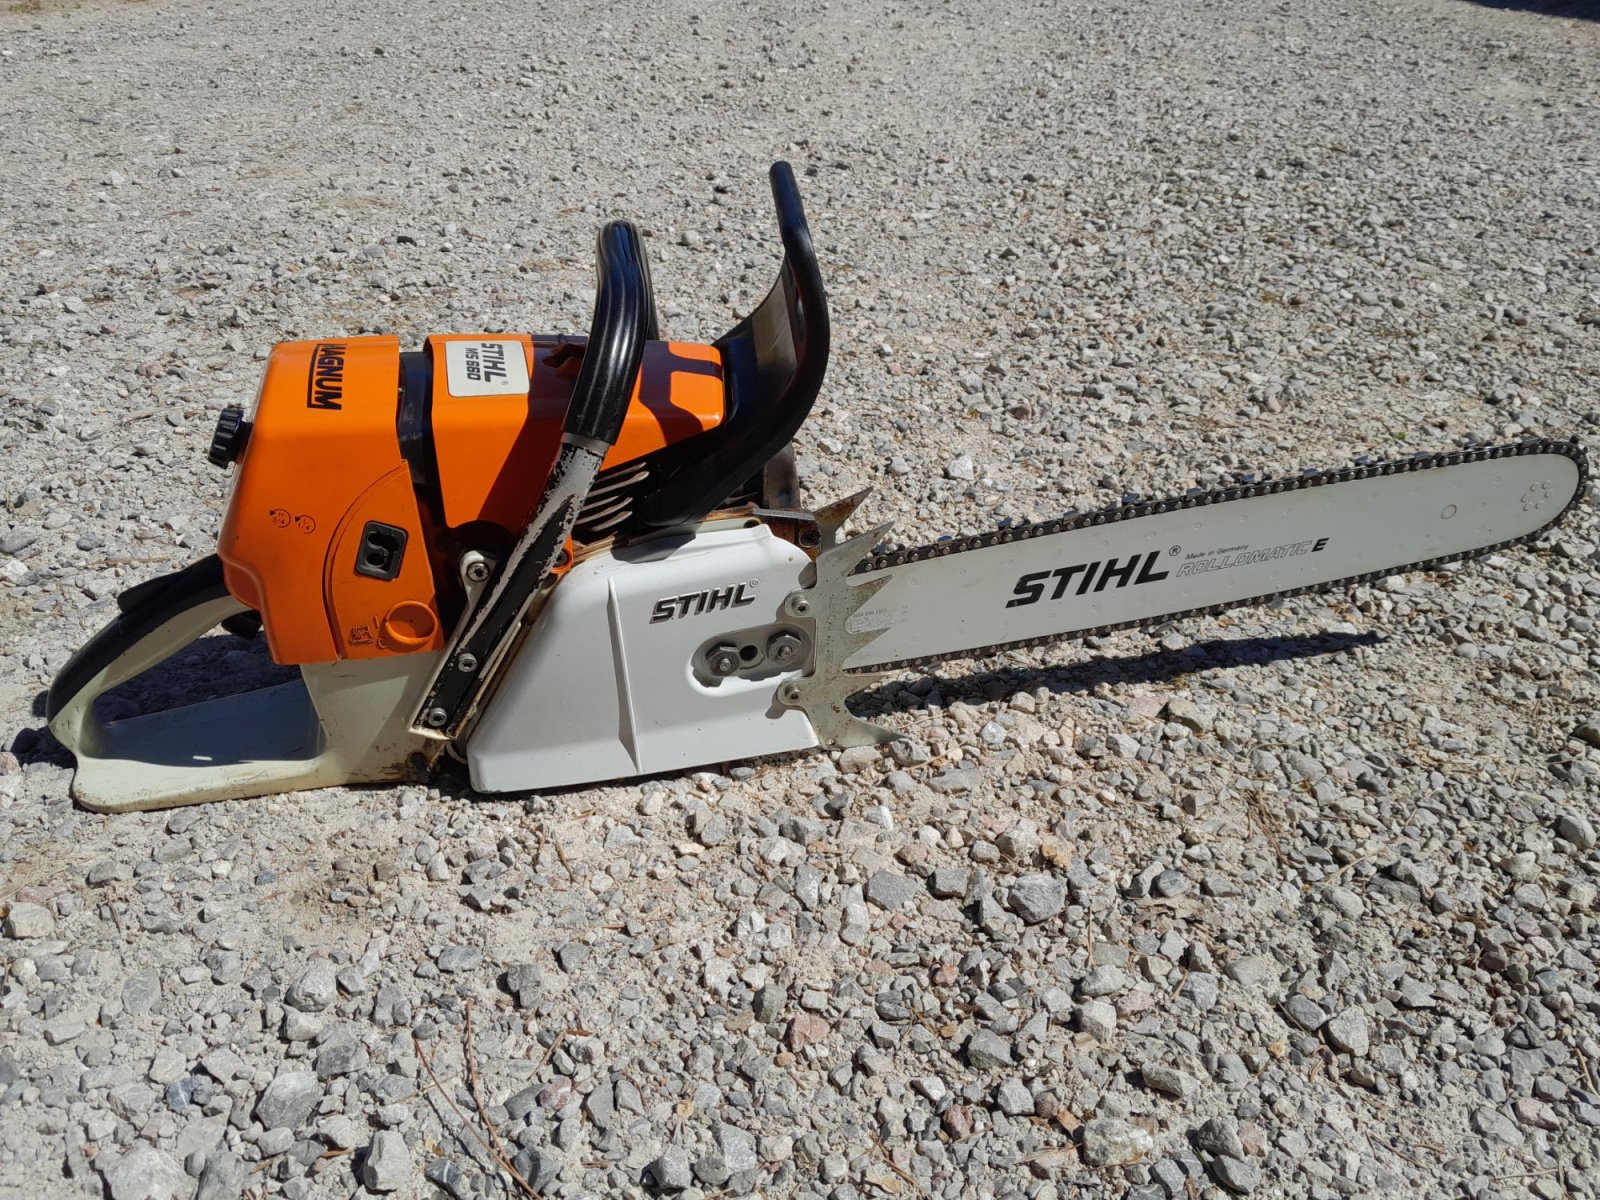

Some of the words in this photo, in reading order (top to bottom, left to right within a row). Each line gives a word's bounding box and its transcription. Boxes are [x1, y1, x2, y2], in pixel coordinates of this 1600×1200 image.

[465, 347, 480, 360] MS
[466, 360, 481, 381] 660
[481, 343, 507, 382] STIHL
[314, 344, 347, 410] MAGNUM
[1176, 540, 1313, 577] ROLLOMATIC
[1311, 537, 1330, 552] E
[1185, 551, 1206, 560] Made
[1216, 544, 1249, 555] Germany
[1005, 550, 1170, 609] STIHL
[649, 582, 756, 625] STIHL
